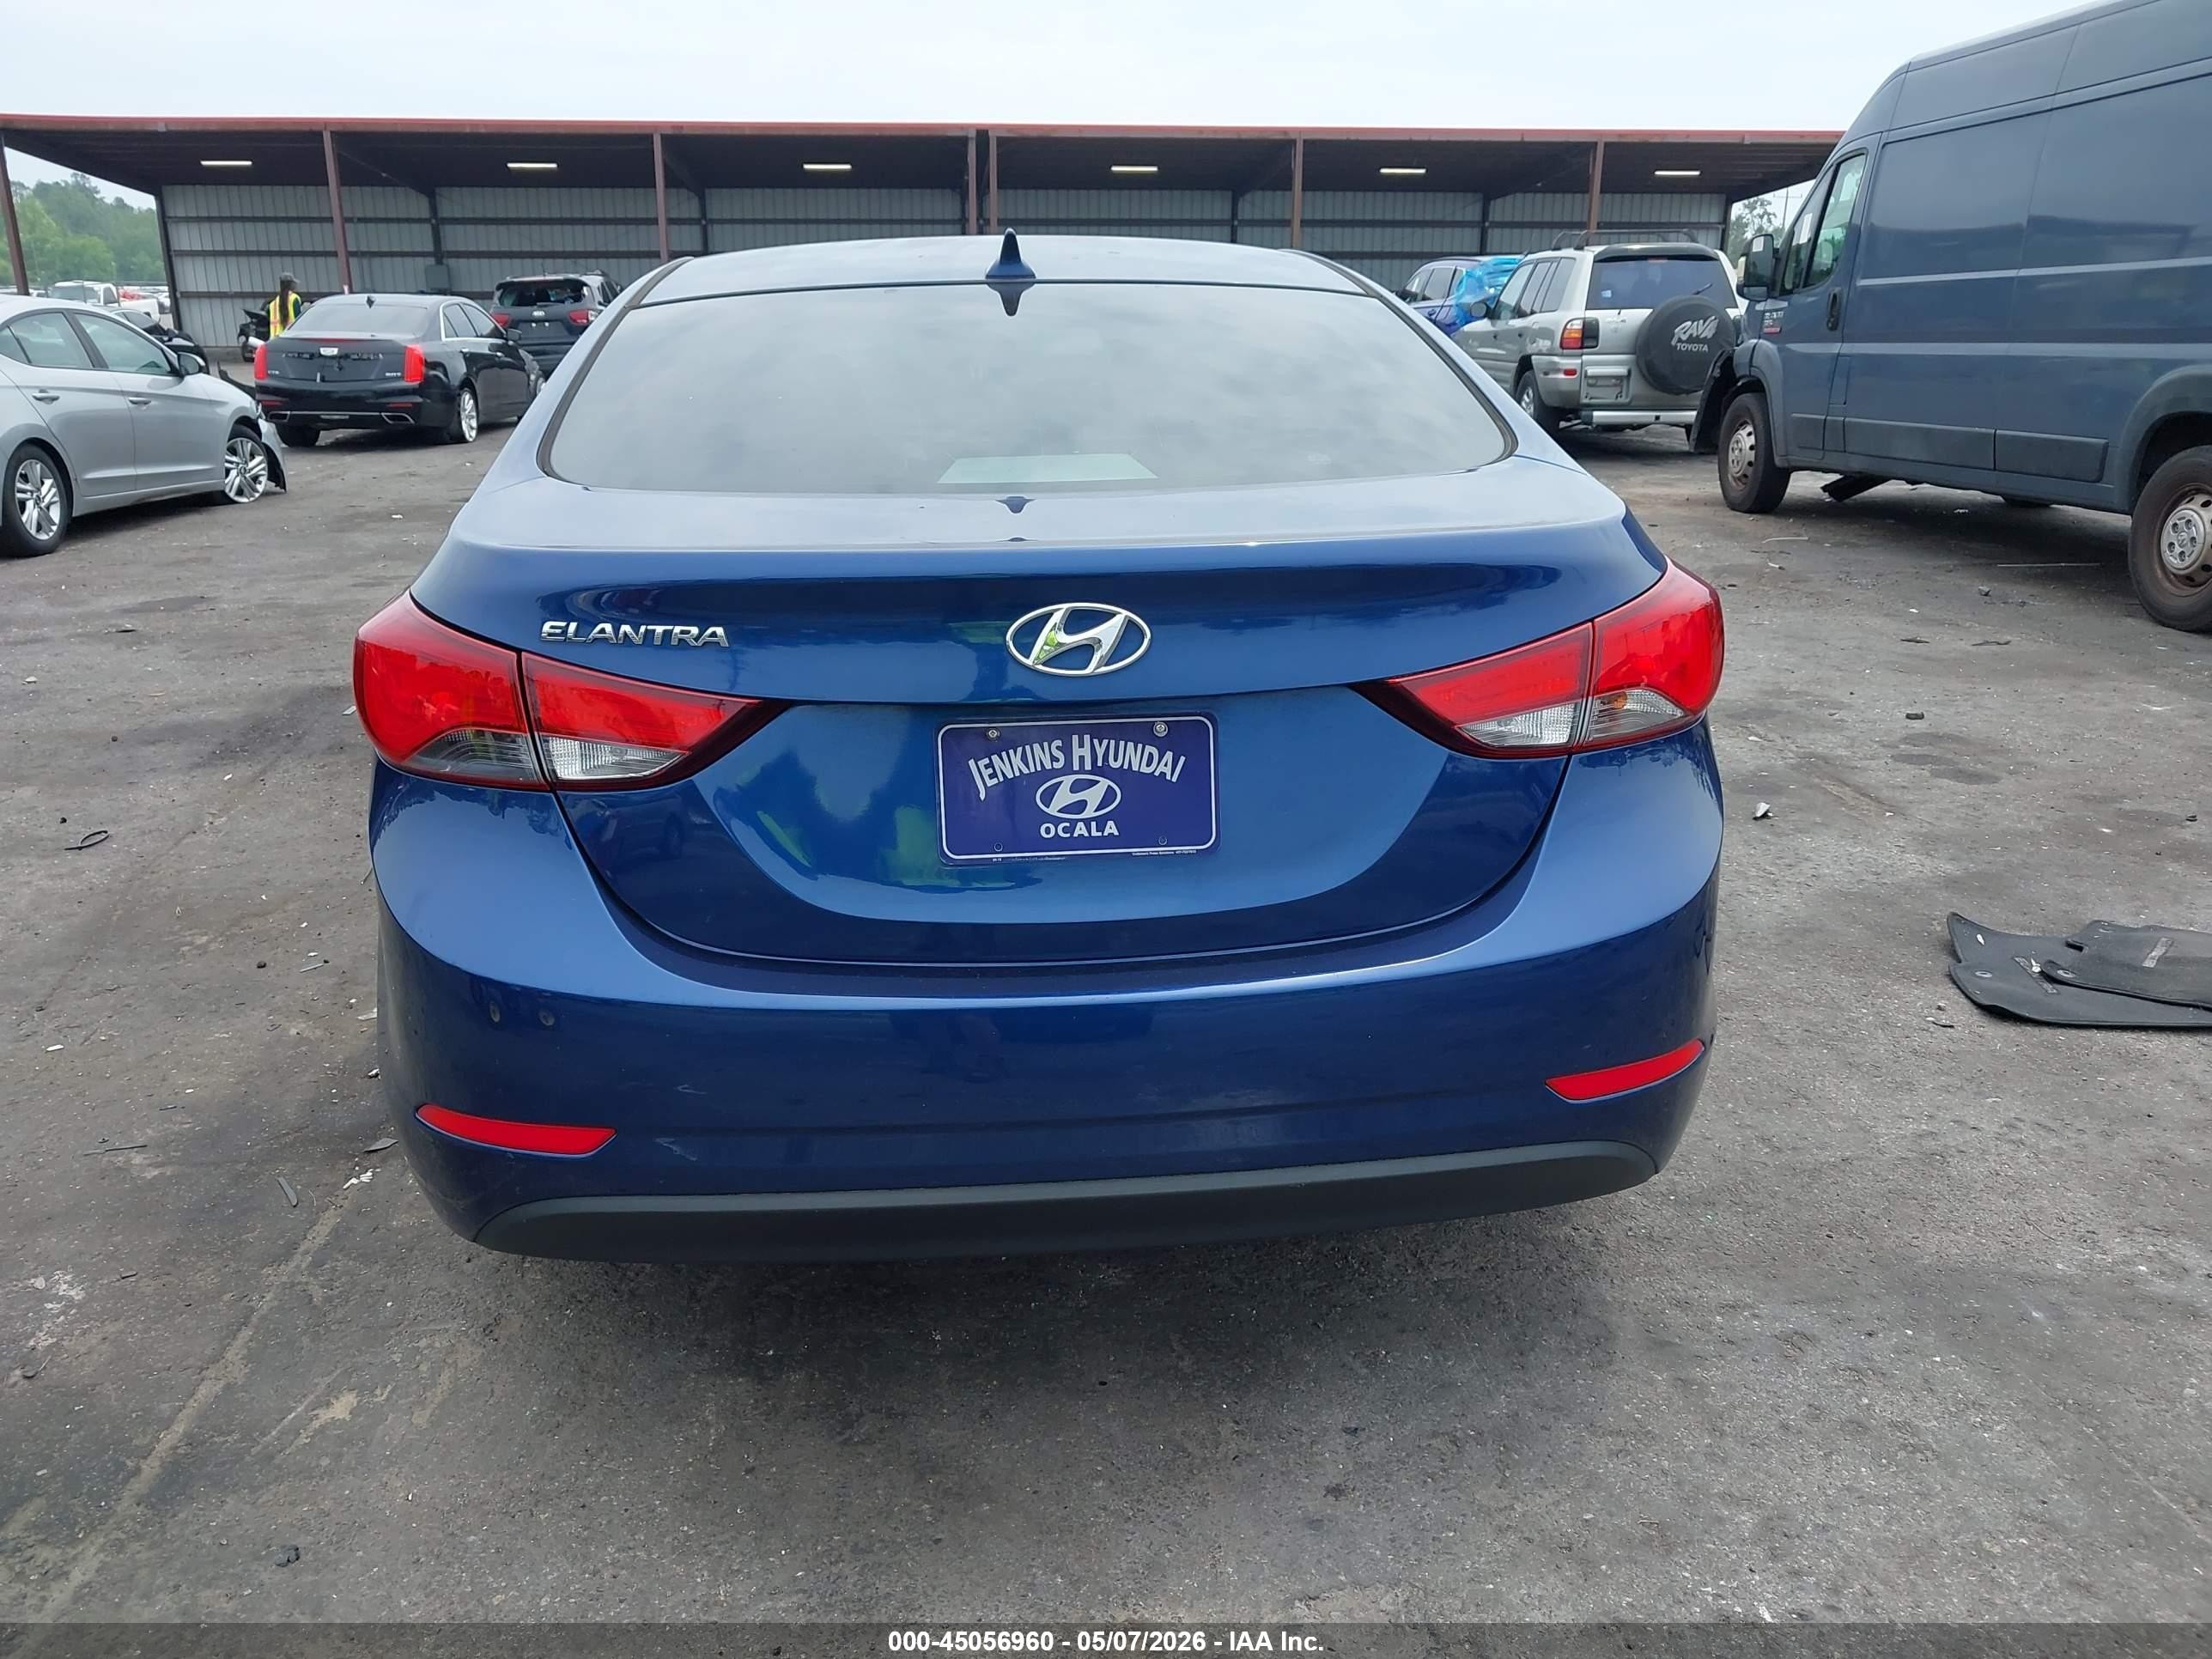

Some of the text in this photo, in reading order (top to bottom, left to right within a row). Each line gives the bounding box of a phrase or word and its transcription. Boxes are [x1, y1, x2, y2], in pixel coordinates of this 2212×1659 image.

[1676, 342, 1709, 353] TOYOTA
[540, 621, 729, 647] ELANTRA
[968, 734, 1186, 801] JENKINS HYUNDAI
[1040, 820, 1119, 839] OCALA
